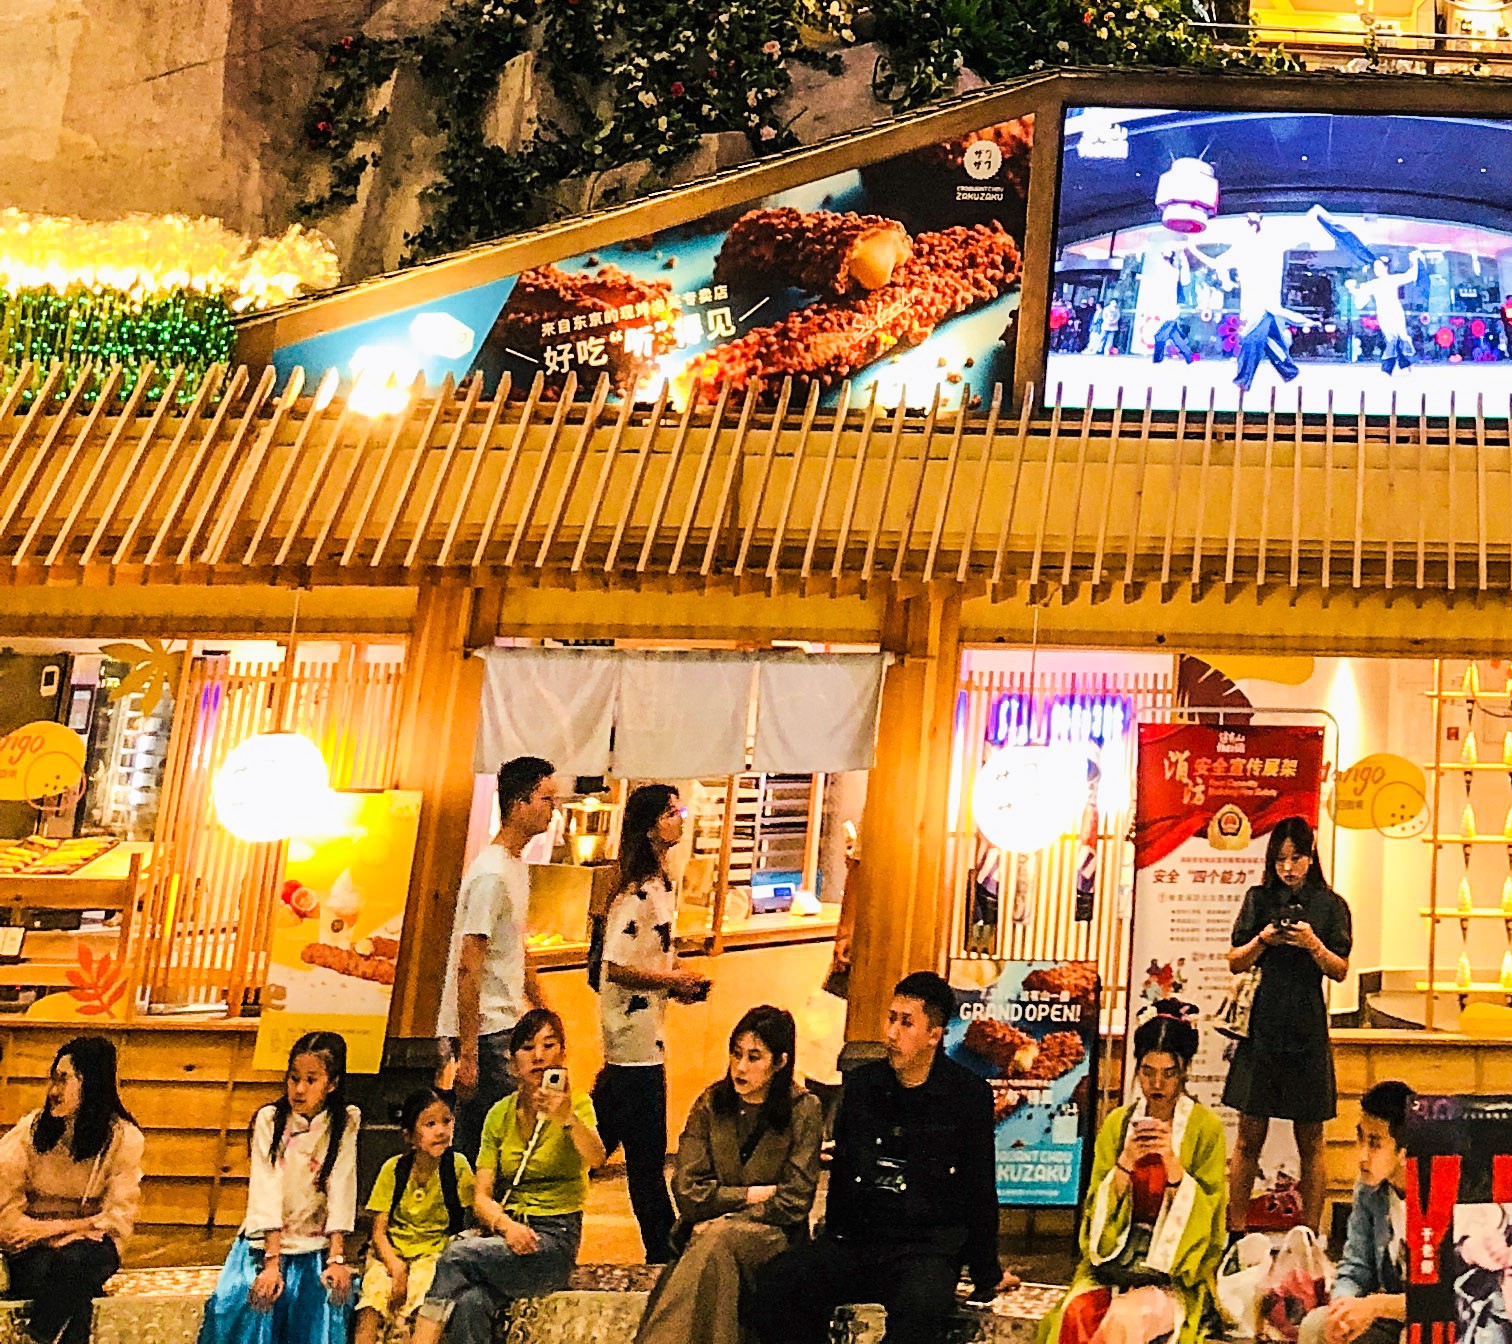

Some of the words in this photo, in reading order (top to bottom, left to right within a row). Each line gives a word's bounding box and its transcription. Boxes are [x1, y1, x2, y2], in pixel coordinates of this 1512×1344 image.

[956, 193, 1003, 201] ZAKUZAKU
[960, 1002, 1022, 1022] GRAND
[1025, 1003, 1082, 1023] OPEN!
